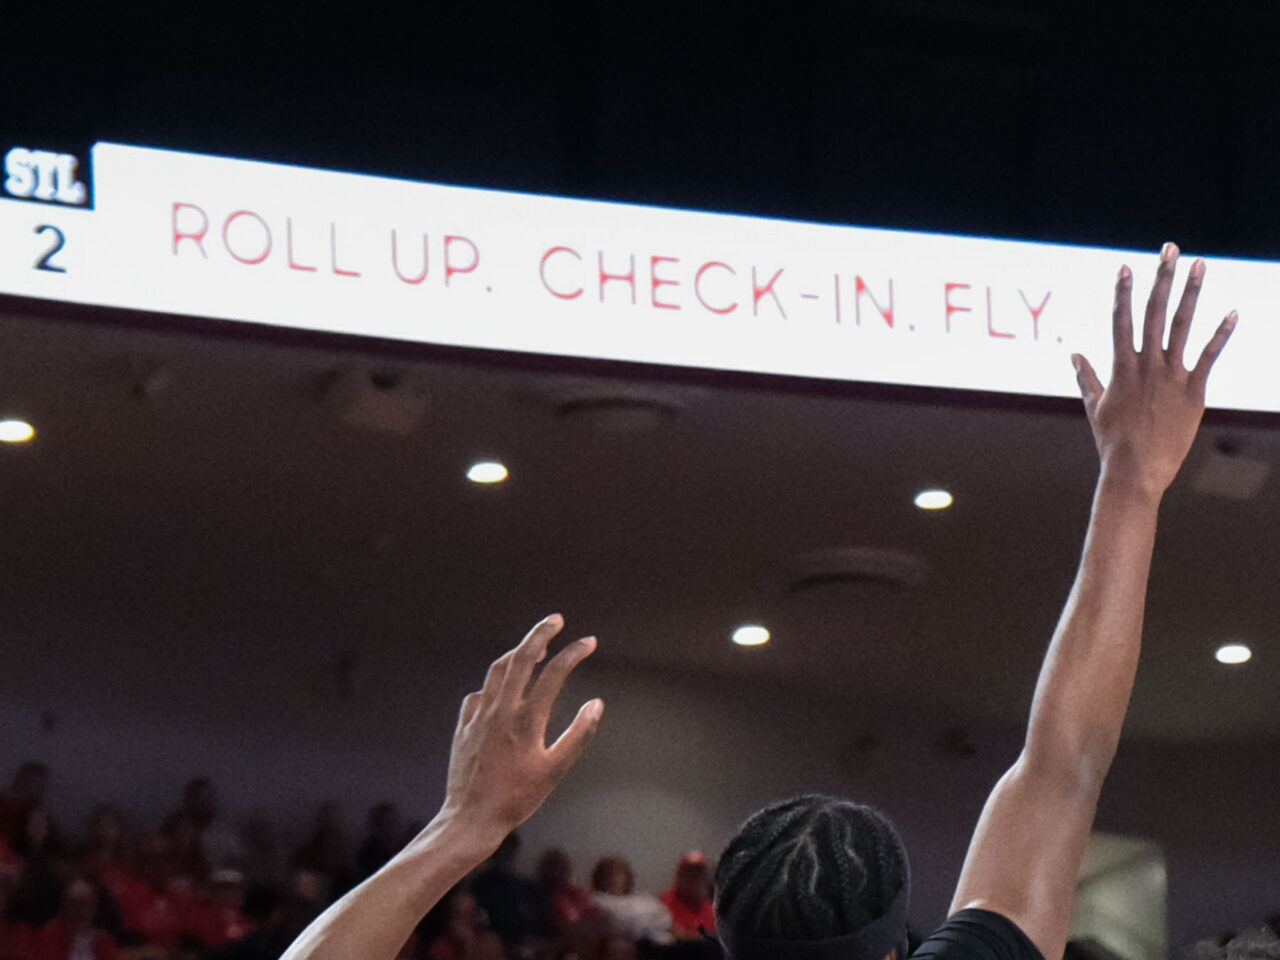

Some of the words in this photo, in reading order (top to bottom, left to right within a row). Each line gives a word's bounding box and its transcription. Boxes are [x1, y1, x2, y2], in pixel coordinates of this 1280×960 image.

[4, 147, 87, 204] STL
[33, 224, 67, 273] 2
[171, 201, 362, 278] ROLL
[391, 229, 493, 293] UP.
[539, 245, 915, 332] CHECK-IN.
[943, 281, 1064, 343] FLY.
